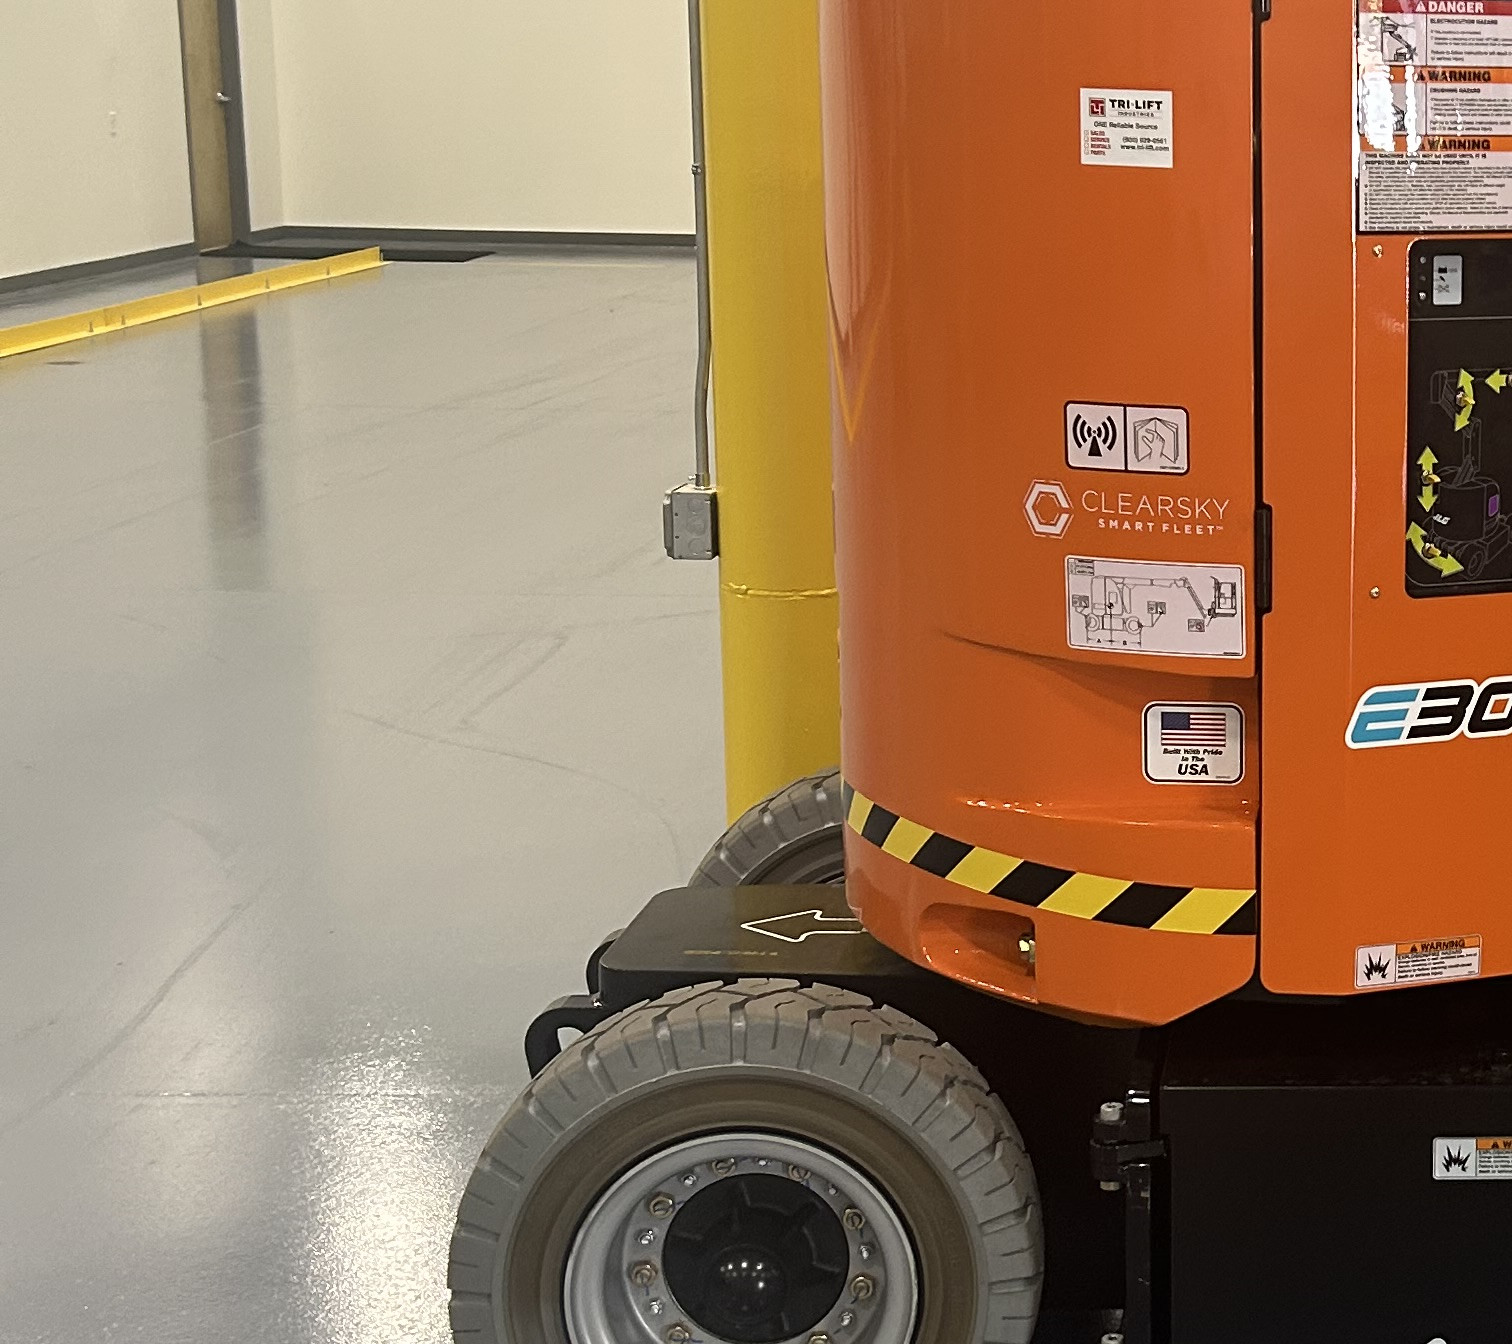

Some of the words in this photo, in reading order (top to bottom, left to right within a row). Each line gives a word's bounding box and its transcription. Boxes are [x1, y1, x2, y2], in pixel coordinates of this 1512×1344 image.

[1428, 1, 1484, 13] DANGER
[1428, 70, 1492, 82] WARNING
[1108, 121, 1134, 129] Reliable
[1427, 139, 1491, 150] WARNING
[1081, 490, 1230, 520] CLEARSKY
[1098, 519, 1154, 533] SMART
[1177, 764, 1209, 775] USA
[1421, 938, 1465, 952] WARNING
